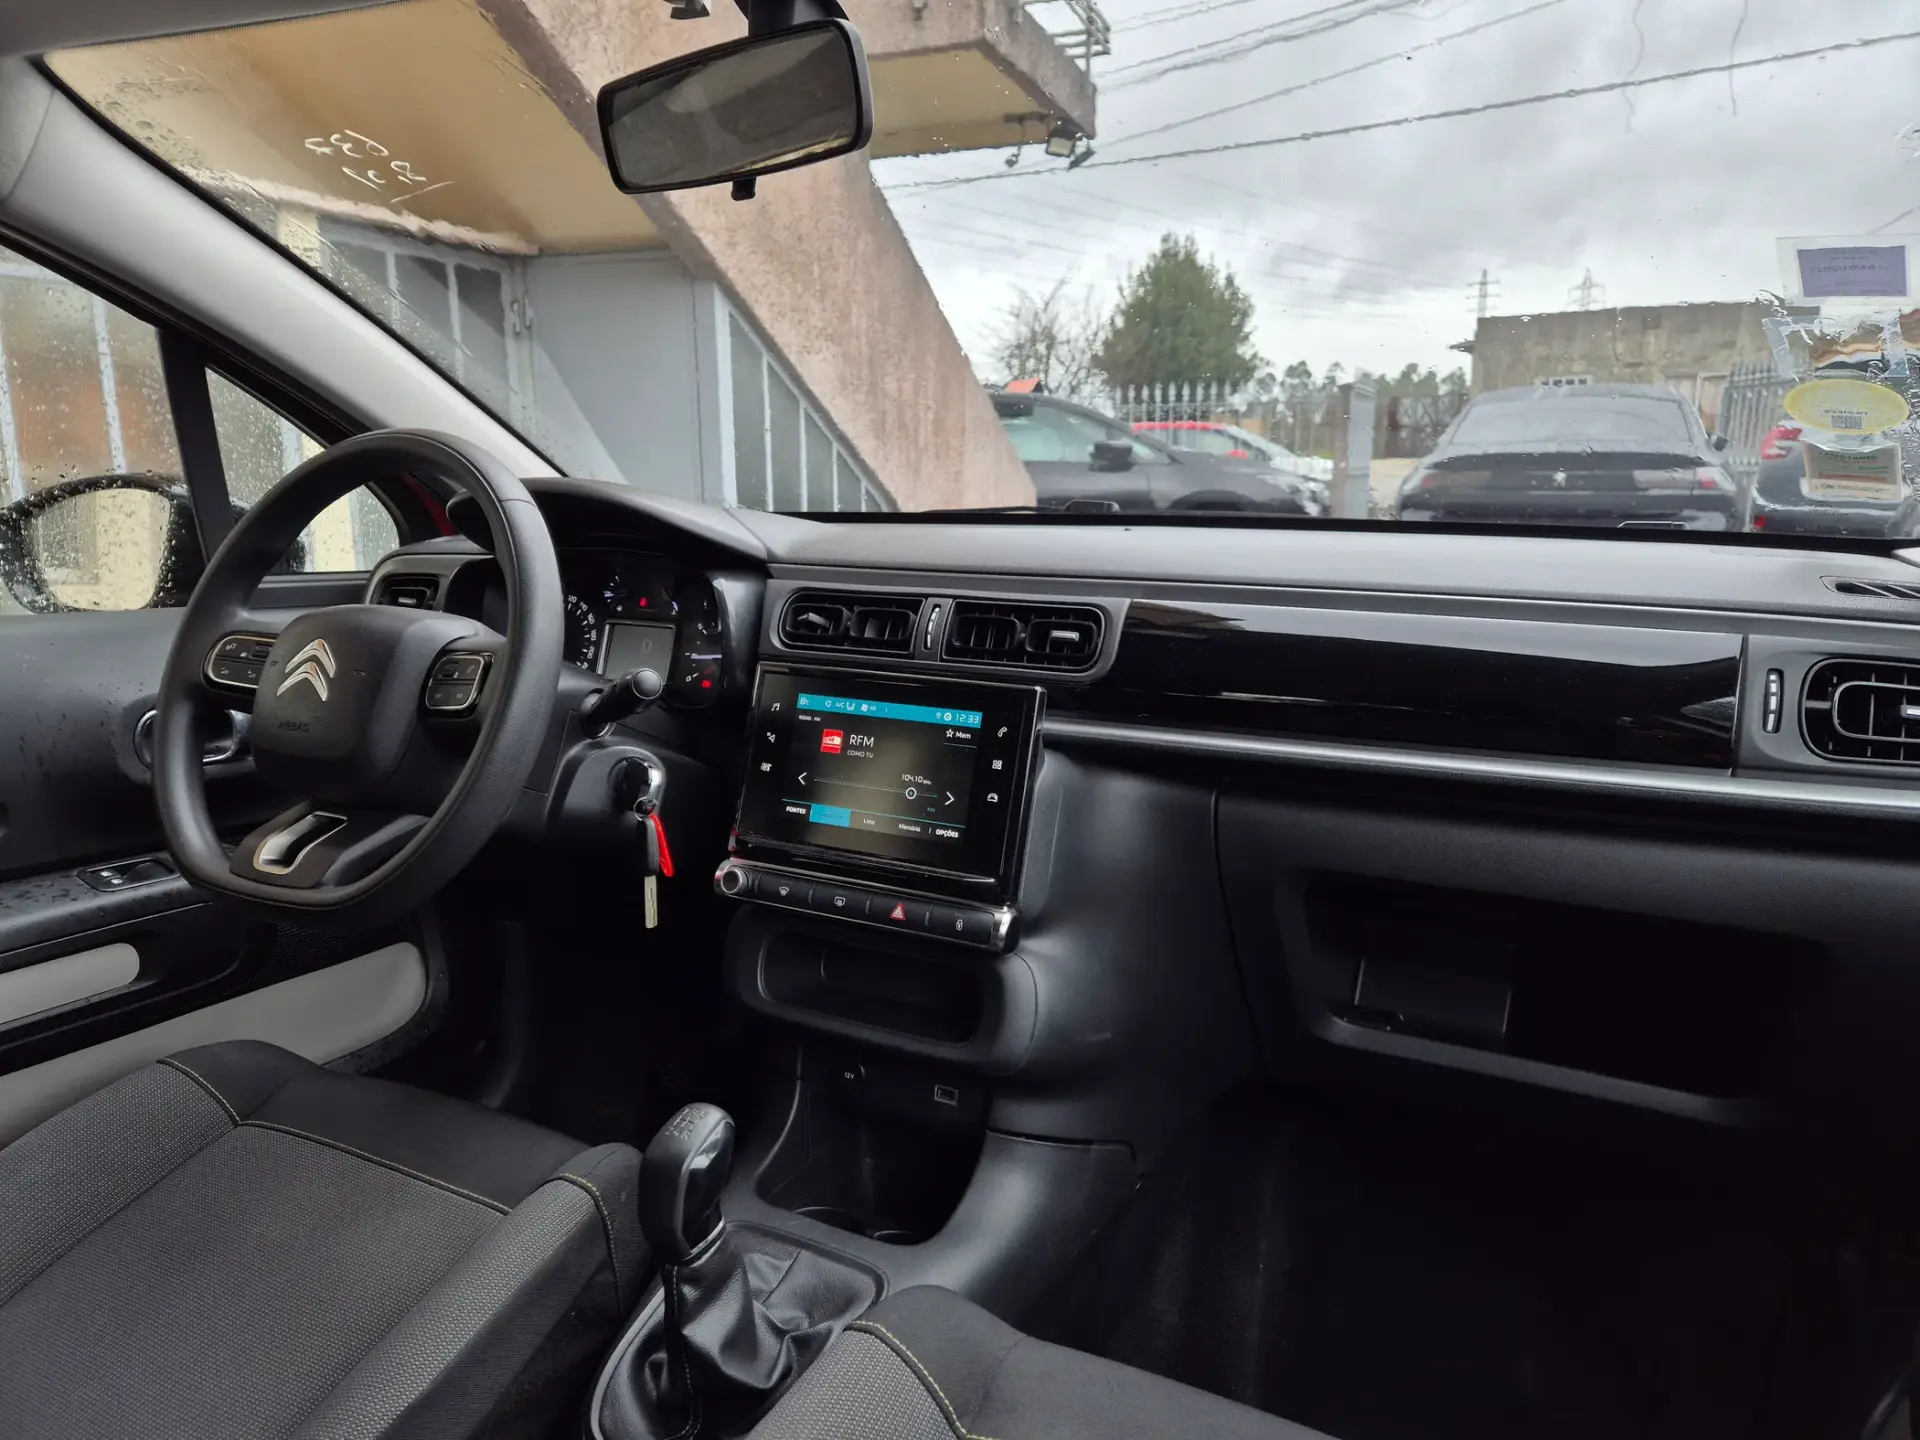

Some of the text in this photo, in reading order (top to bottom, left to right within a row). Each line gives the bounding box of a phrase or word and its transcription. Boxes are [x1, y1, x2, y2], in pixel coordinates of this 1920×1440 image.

[641, 639, 652, 654] 0
[849, 734, 874, 748] RFM
[847, 749, 865, 758] COMO
[785, 805, 807, 815] FONTES
[935, 828, 959, 838] OPÇÕES
[844, 1071, 855, 1079] 12V
